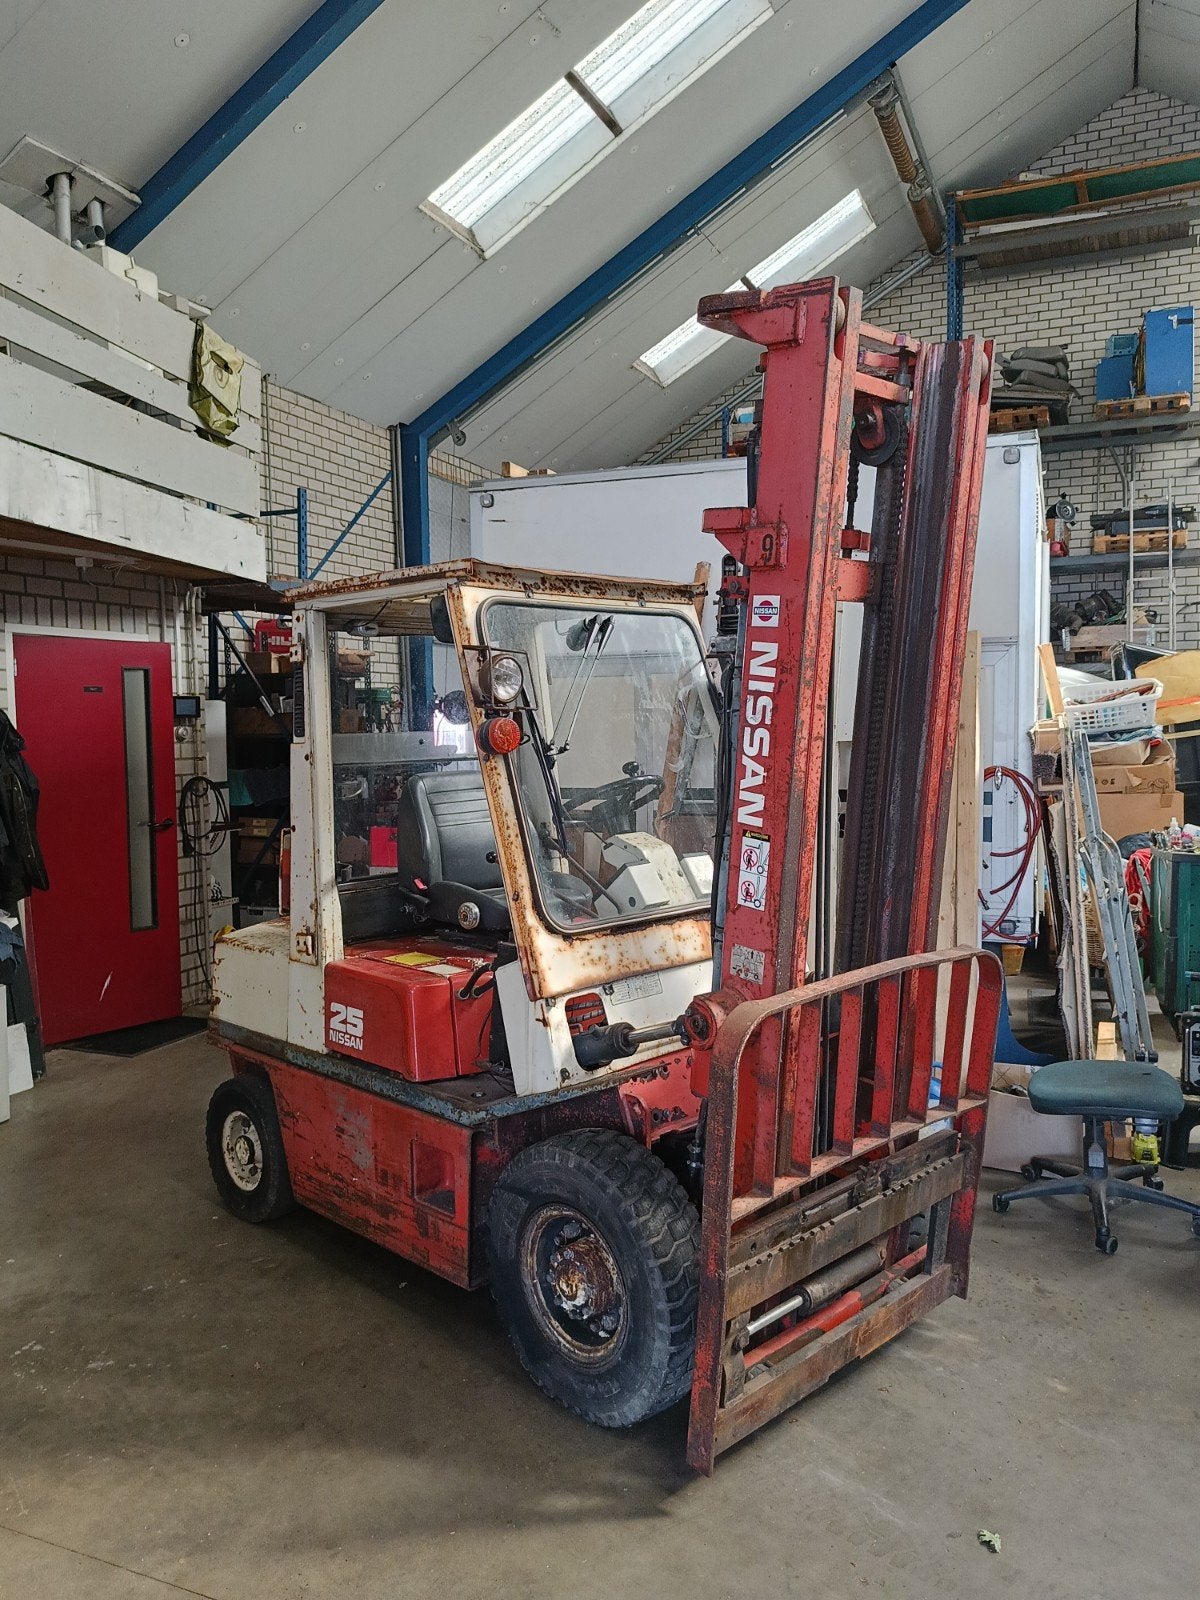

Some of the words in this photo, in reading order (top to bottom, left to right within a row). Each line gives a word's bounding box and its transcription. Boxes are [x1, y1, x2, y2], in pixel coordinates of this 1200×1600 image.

[754, 607, 778, 615] NISSAN
[268, 635, 291, 646] HIL
[737, 641, 779, 827] NISSAN
[330, 1002, 364, 1037] 25
[329, 1029, 363, 1050] NISSAN
